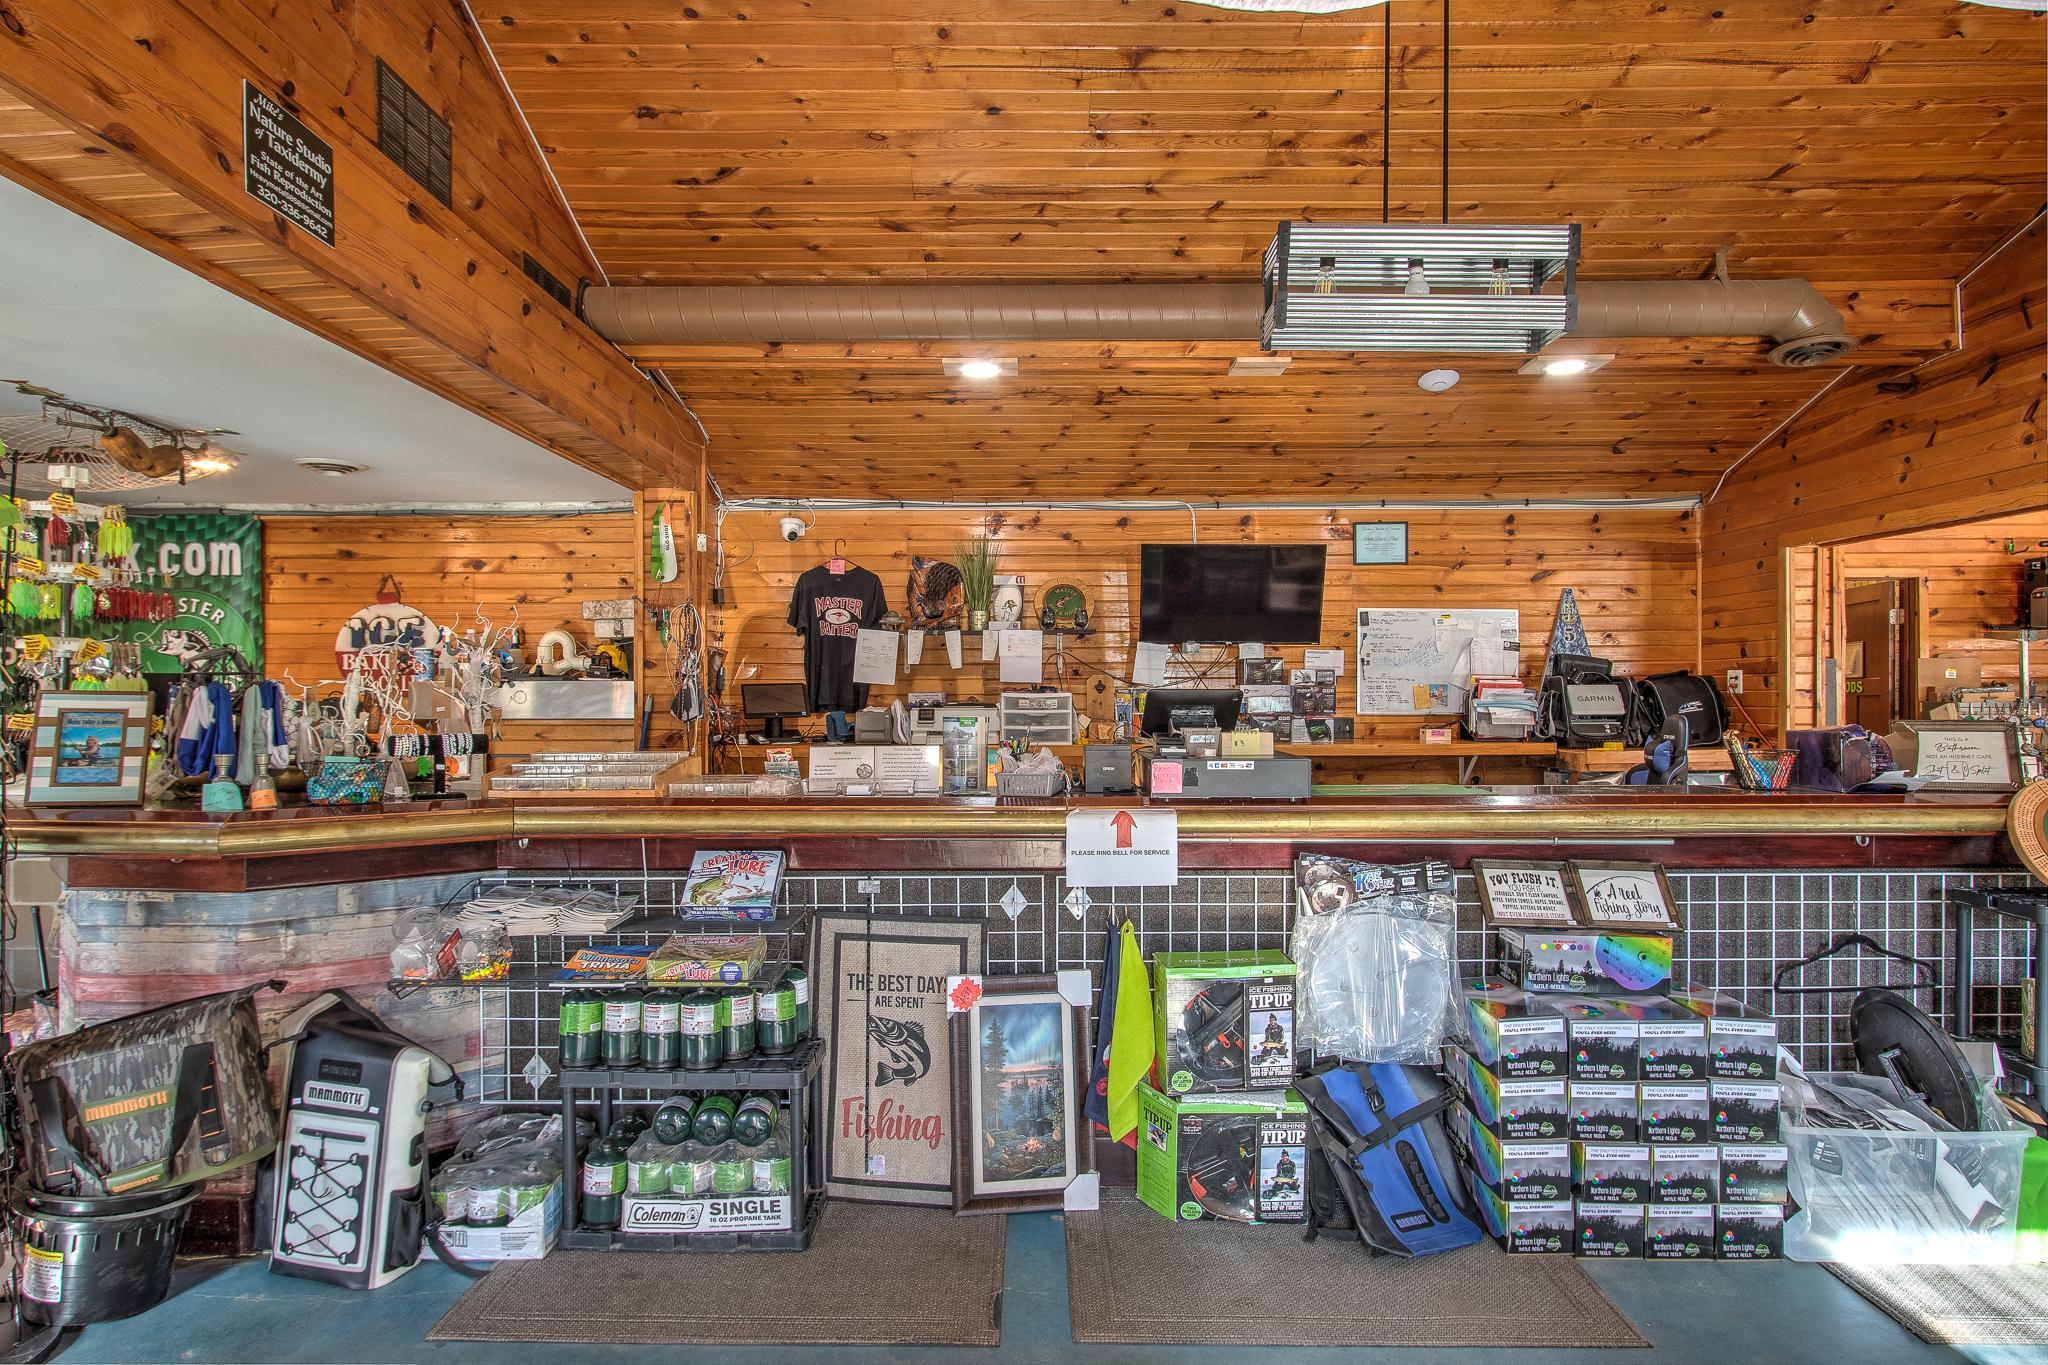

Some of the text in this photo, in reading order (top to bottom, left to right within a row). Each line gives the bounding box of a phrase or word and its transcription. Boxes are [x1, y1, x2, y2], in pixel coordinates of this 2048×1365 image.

[254, 94, 283, 121] Mike's
[250, 102, 332, 174] Nature Studio
[255, 128, 327, 189] of Taxidermy
[261, 152, 322, 200] State of the Art
[250, 154, 332, 218] Fish Reproduction
[258, 185, 328, 238] 320-336-9642
[815, 597, 863, 620] MASTER
[348, 616, 425, 648] ICE
[820, 621, 858, 638] BAITER
[1564, 627, 1576, 642] 5
[1934, 742, 1980, 752] Bathroom
[1951, 765, 1960, 774] &
[727, 861, 768, 876] LURE
[1490, 872, 1558, 888] YOU FLUSH IT.
[1607, 883, 1642, 900] A reel
[1633, 901, 1664, 918] story
[579, 954, 640, 964] Minnesota
[686, 970, 714, 980] LURE
[1528, 972, 1570, 982] Northern Lights
[847, 973, 873, 991] THE
[878, 976, 913, 993] BEST
[875, 996, 924, 1008] ARE SPENT
[1250, 993, 1292, 1008] TIP UP
[1508, 1061, 1540, 1070] Northern Lights
[1596, 1064, 1609, 1072] Lights
[1665, 1064, 1678, 1072] Lights
[1715, 1062, 1748, 1070] Northern Lights
[309, 1087, 362, 1105] MAMMOTH
[84, 1090, 168, 1122] MAMMOTH
[842, 1096, 945, 1150] Fishing
[1508, 1123, 1525, 1131] Northern
[1596, 1124, 1608, 1133] Lights
[1261, 1130, 1306, 1144] TIP UP
[1610, 1187, 1622, 1195] Lights
[634, 1206, 685, 1222] Coleman
[709, 1200, 781, 1215] SINGLE
